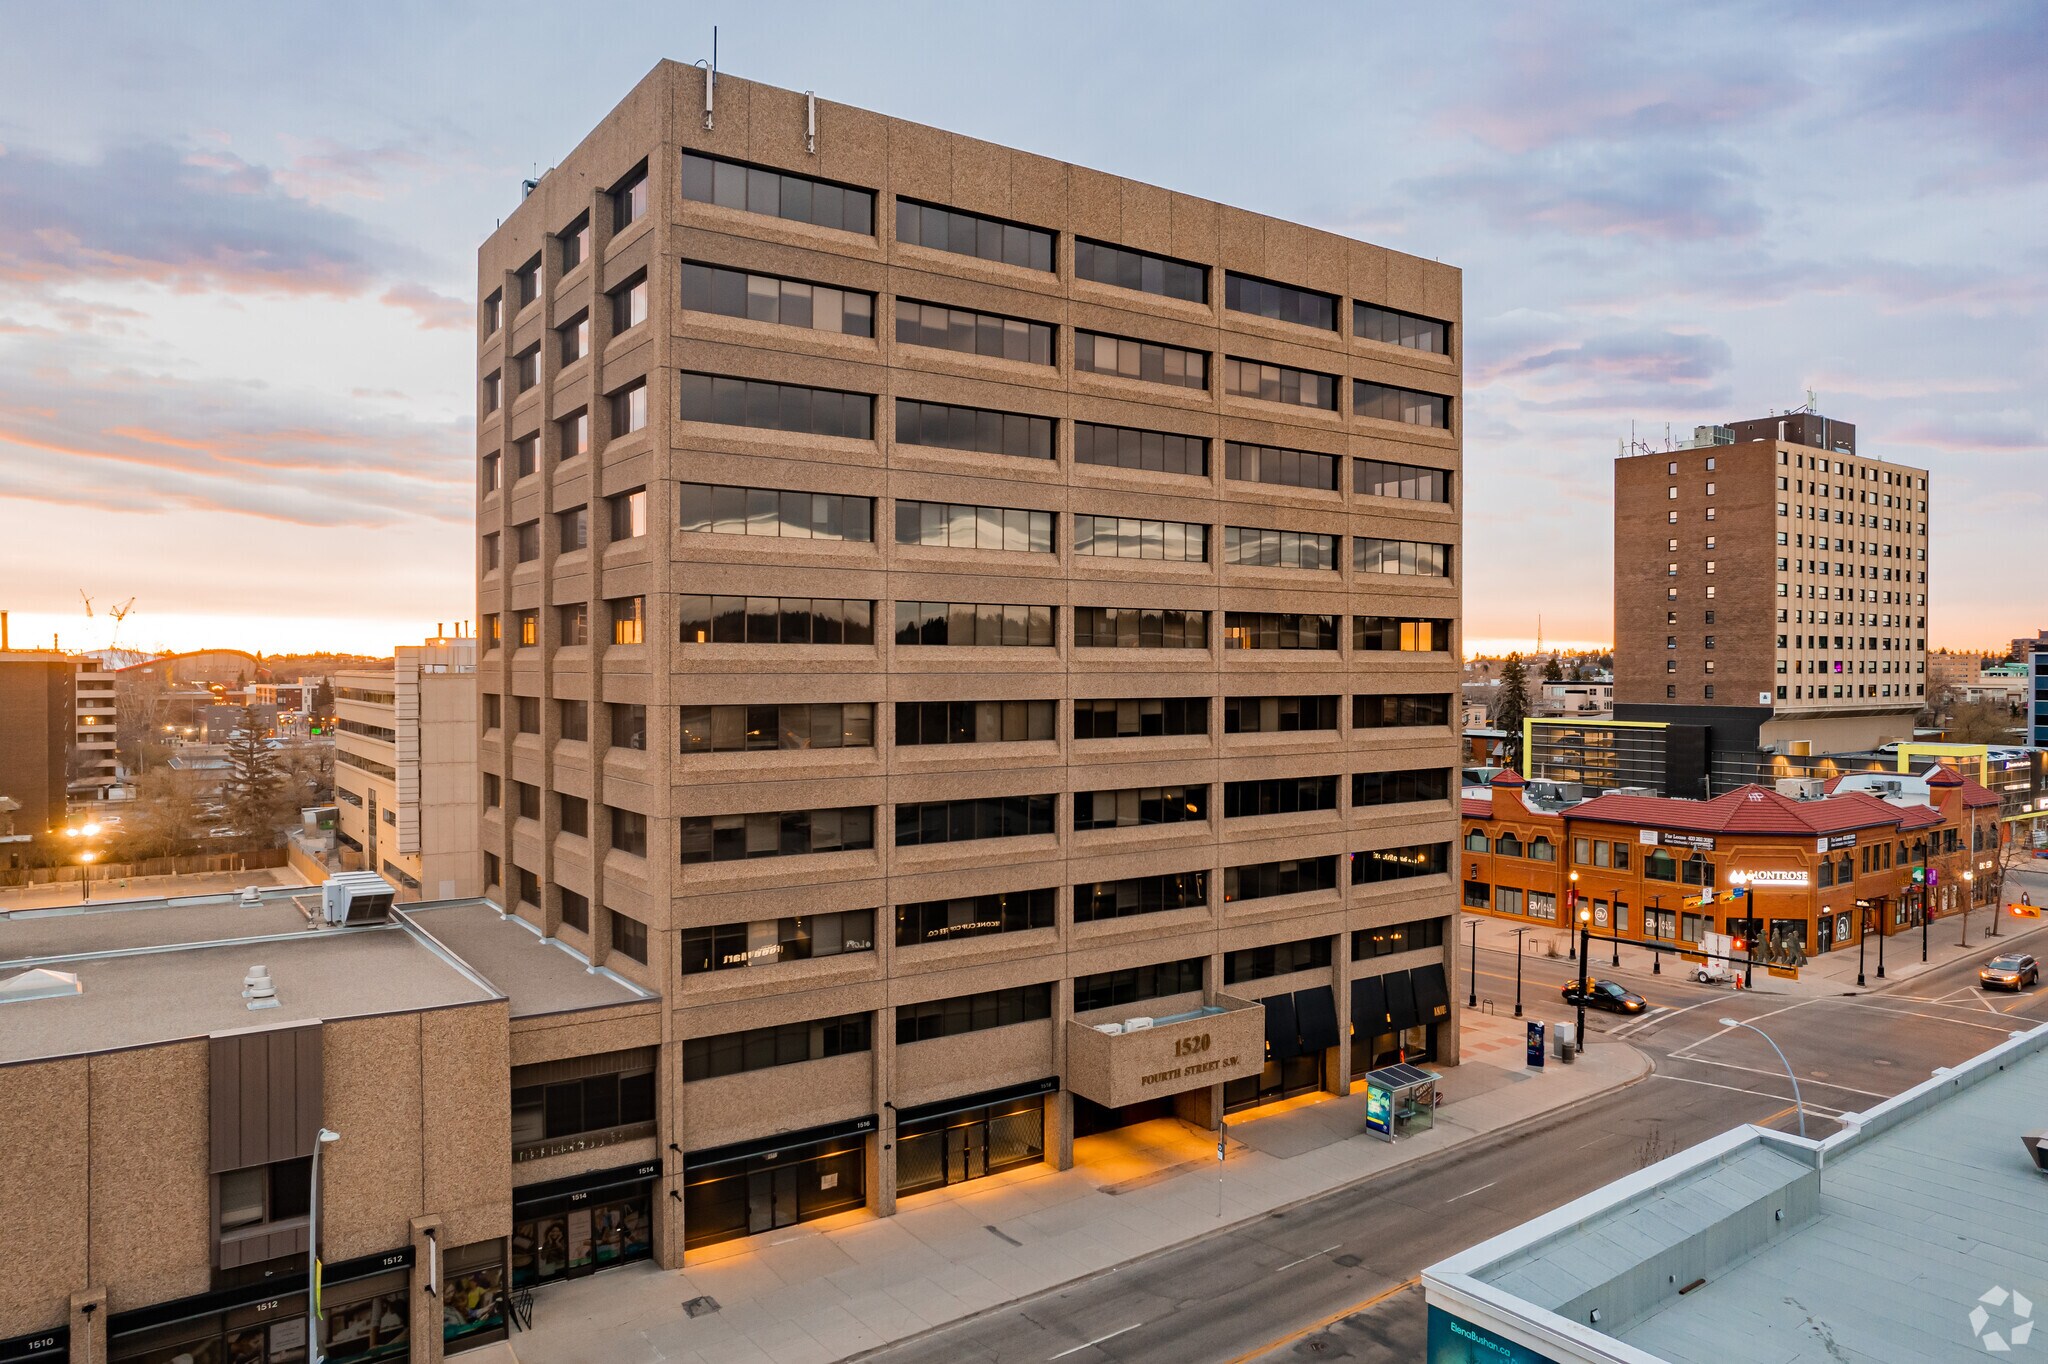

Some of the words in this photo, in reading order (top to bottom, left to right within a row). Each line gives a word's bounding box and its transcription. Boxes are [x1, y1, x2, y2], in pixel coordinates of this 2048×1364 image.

[1174, 1033, 1211, 1058] 1520
[1141, 1068, 1181, 1087] FOURTH
[1184, 1060, 1220, 1077] STREET
[1222, 1056, 1240, 1068] S.W.
[638, 1166, 654, 1175] 1514
[571, 1192, 587, 1201] 1514
[383, 1255, 403, 1266] 1512
[256, 1300, 278, 1312] 1512
[28, 1337, 54, 1350] 1510
[1450, 1321, 1511, 1358] ElenaBushan.ca
